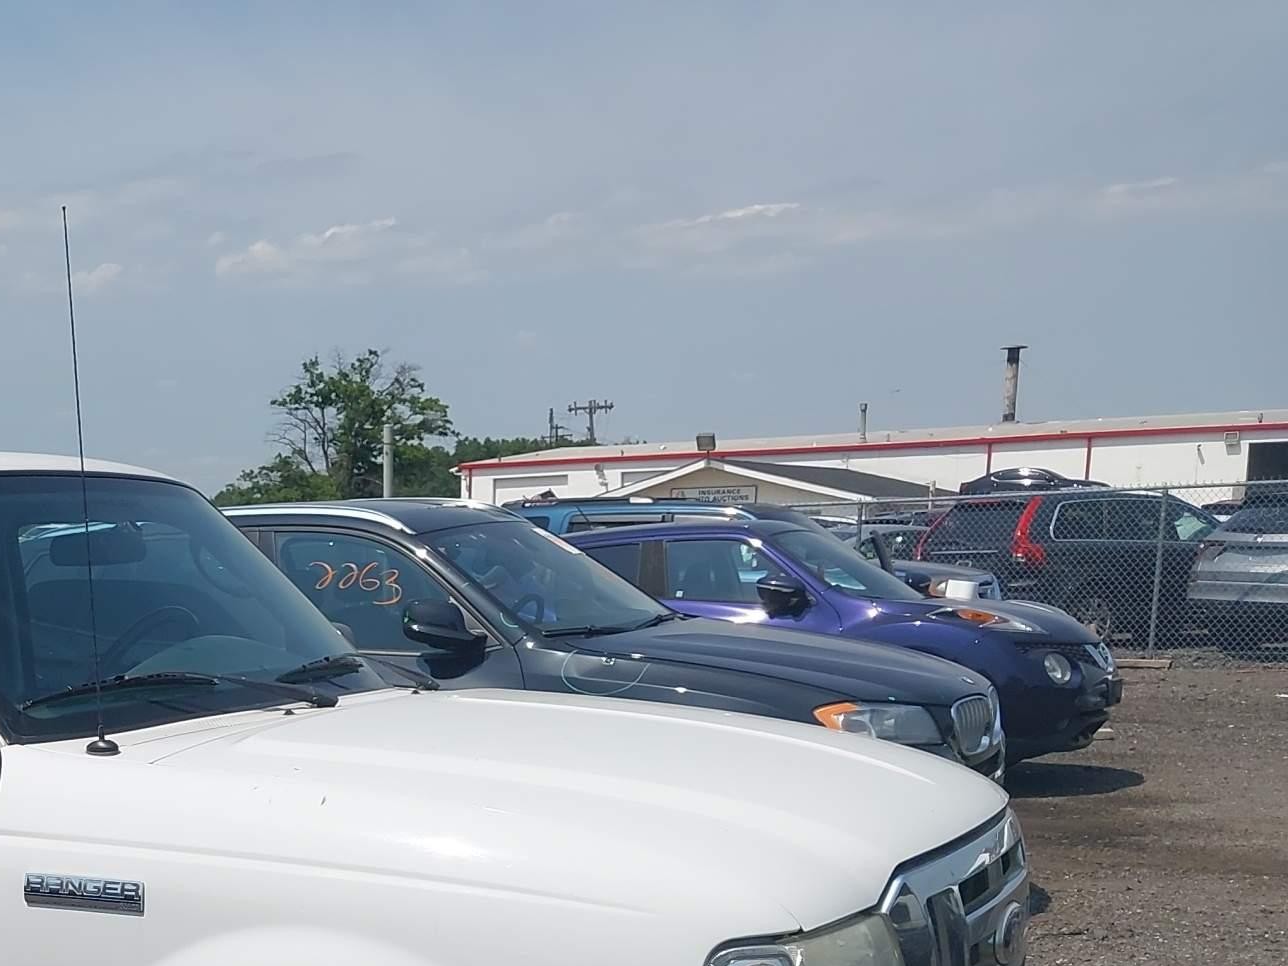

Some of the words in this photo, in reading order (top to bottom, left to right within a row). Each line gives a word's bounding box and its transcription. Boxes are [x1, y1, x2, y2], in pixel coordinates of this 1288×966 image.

[698, 488, 741, 496] INSURANCE
[710, 494, 750, 503] AUCTIONS
[309, 561, 403, 605] 2263
[25, 873, 143, 900] RANGER
